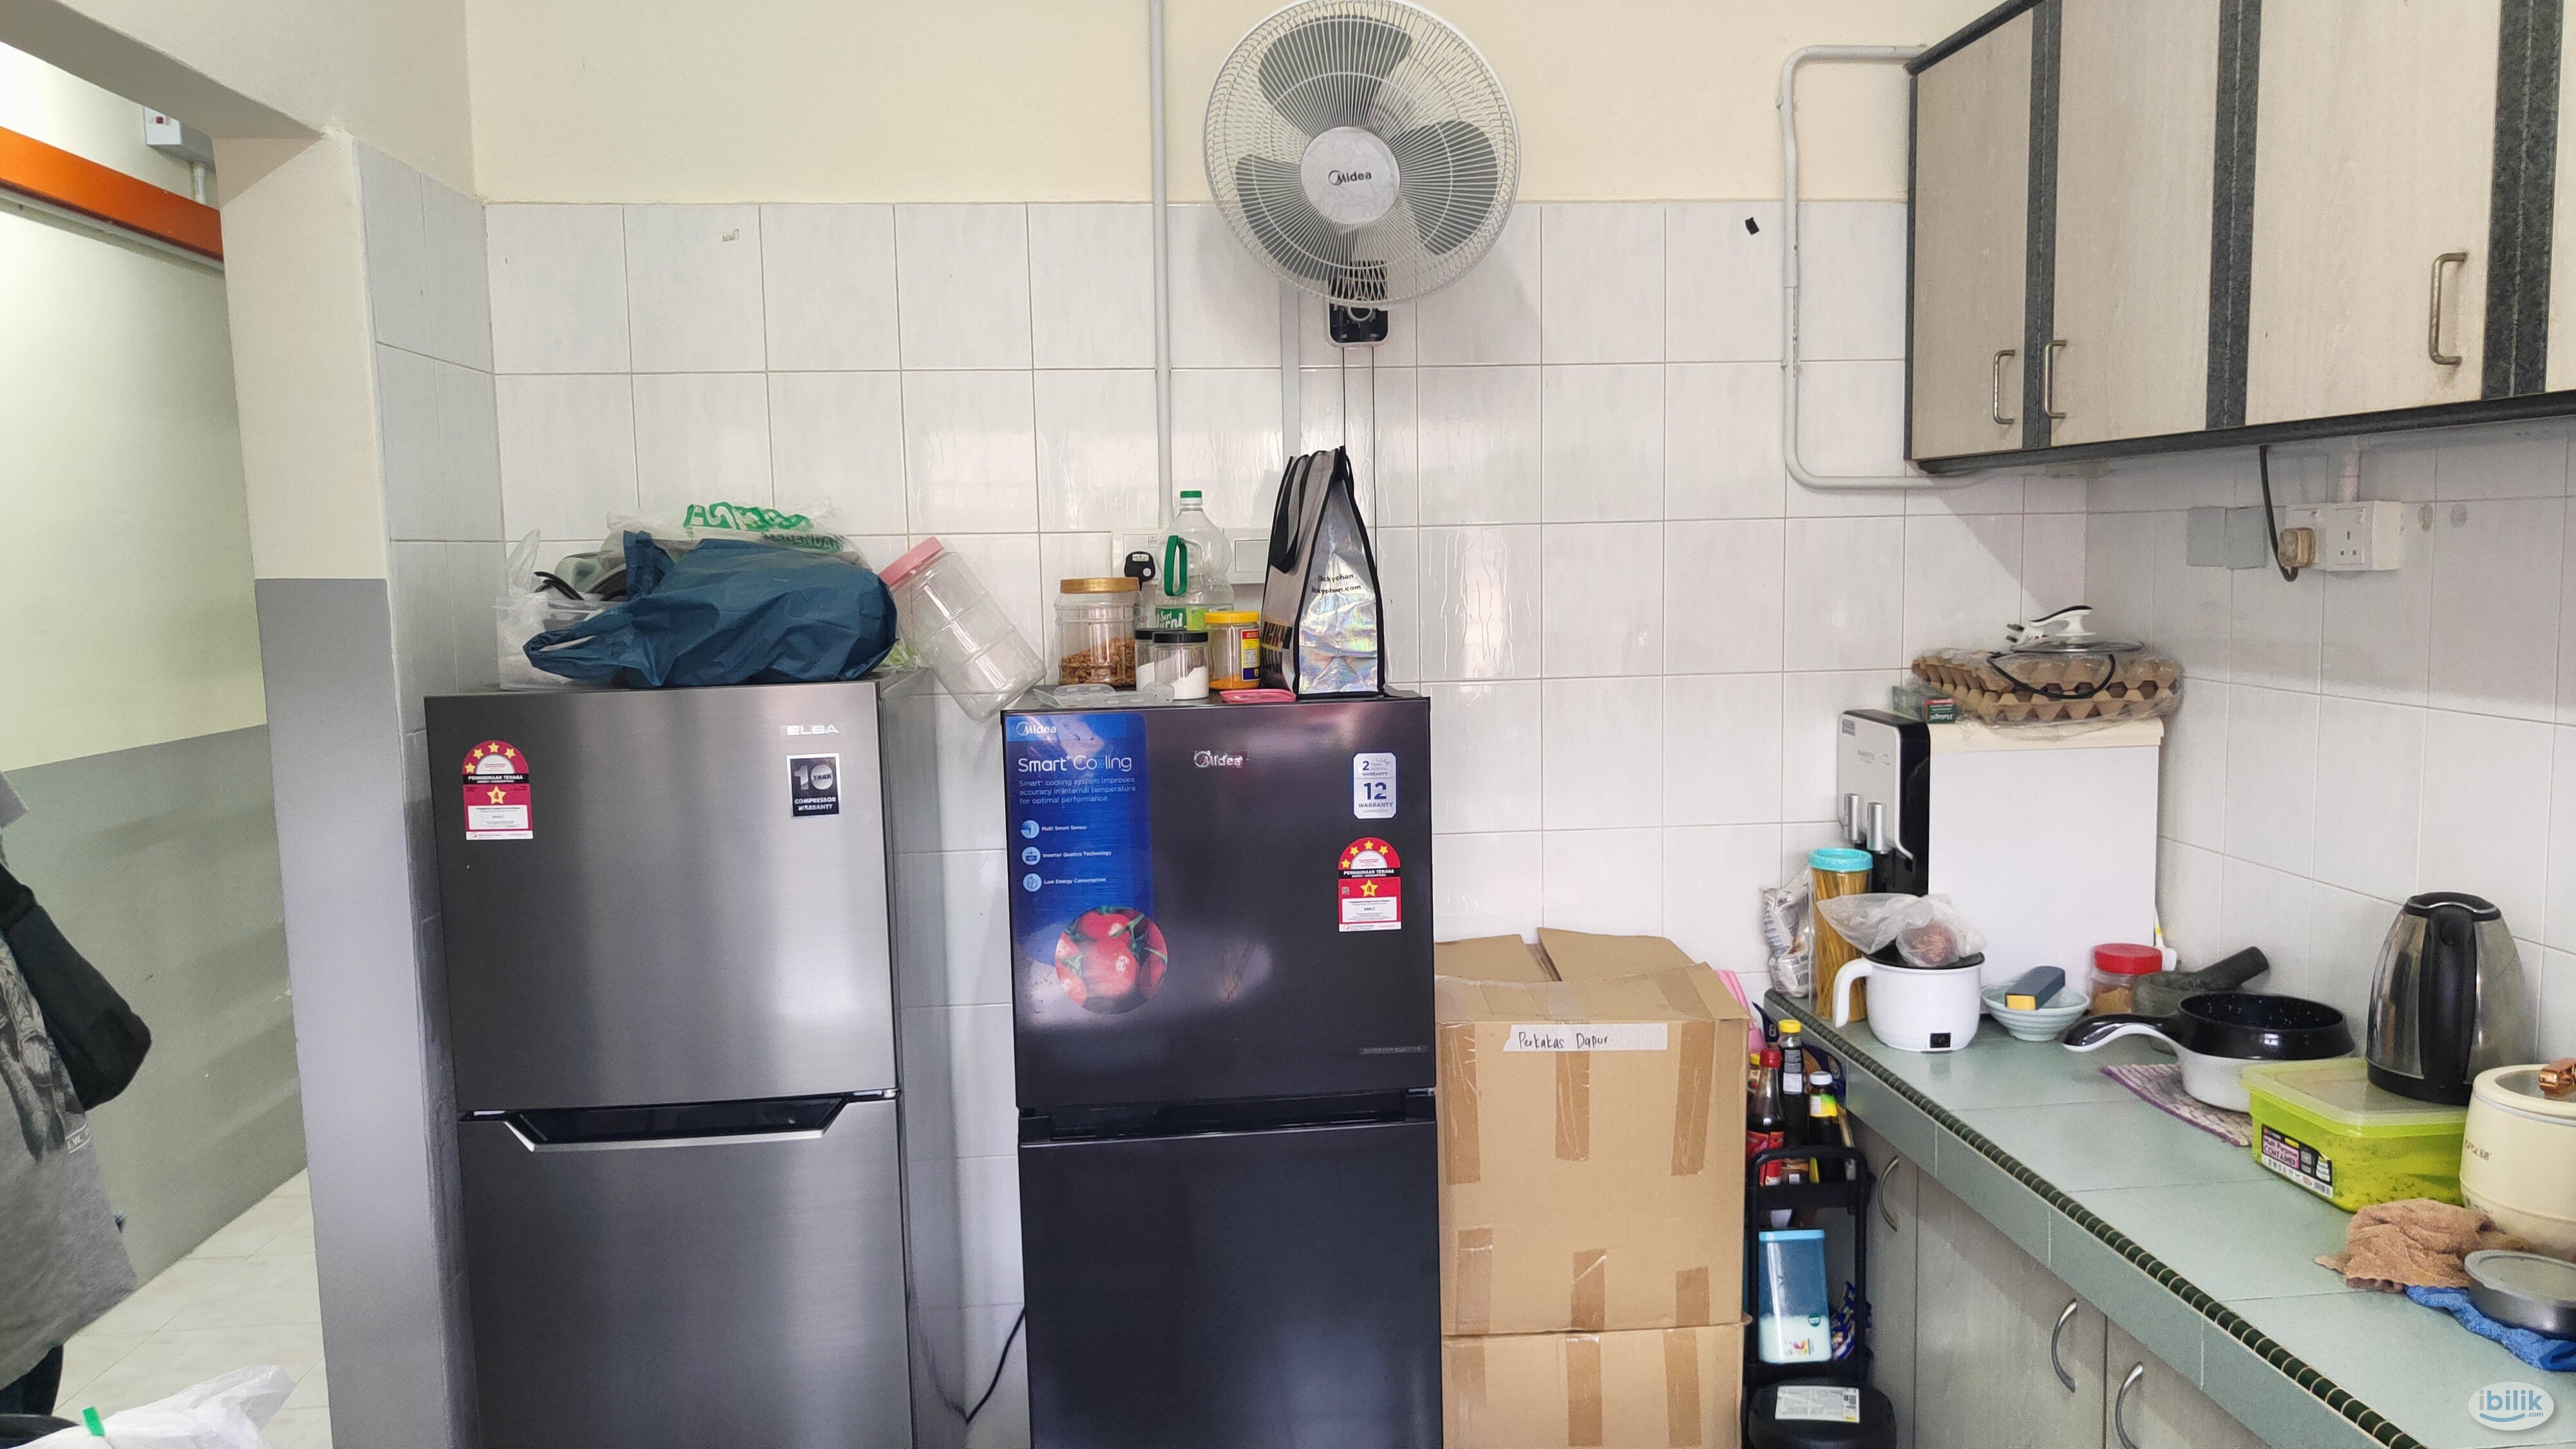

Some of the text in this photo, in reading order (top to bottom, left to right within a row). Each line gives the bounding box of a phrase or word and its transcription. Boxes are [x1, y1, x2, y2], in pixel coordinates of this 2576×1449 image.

[1328, 170, 1372, 185] Midea
[1157, 612, 1183, 629] urni
[787, 724, 840, 735] ELBA
[1016, 721, 1057, 736] Midea
[1194, 750, 1243, 768] Midea
[1362, 761, 1370, 771] 2
[1090, 785, 1136, 793] temperature
[1363, 781, 1387, 800] 12
[794, 796, 837, 805] COMPRESSOR
[1032, 796, 1059, 805] optimal
[1061, 795, 1110, 804] performance.
[1367, 885, 1372, 893] 4
[1519, 1031, 1564, 1049] Perkakas
